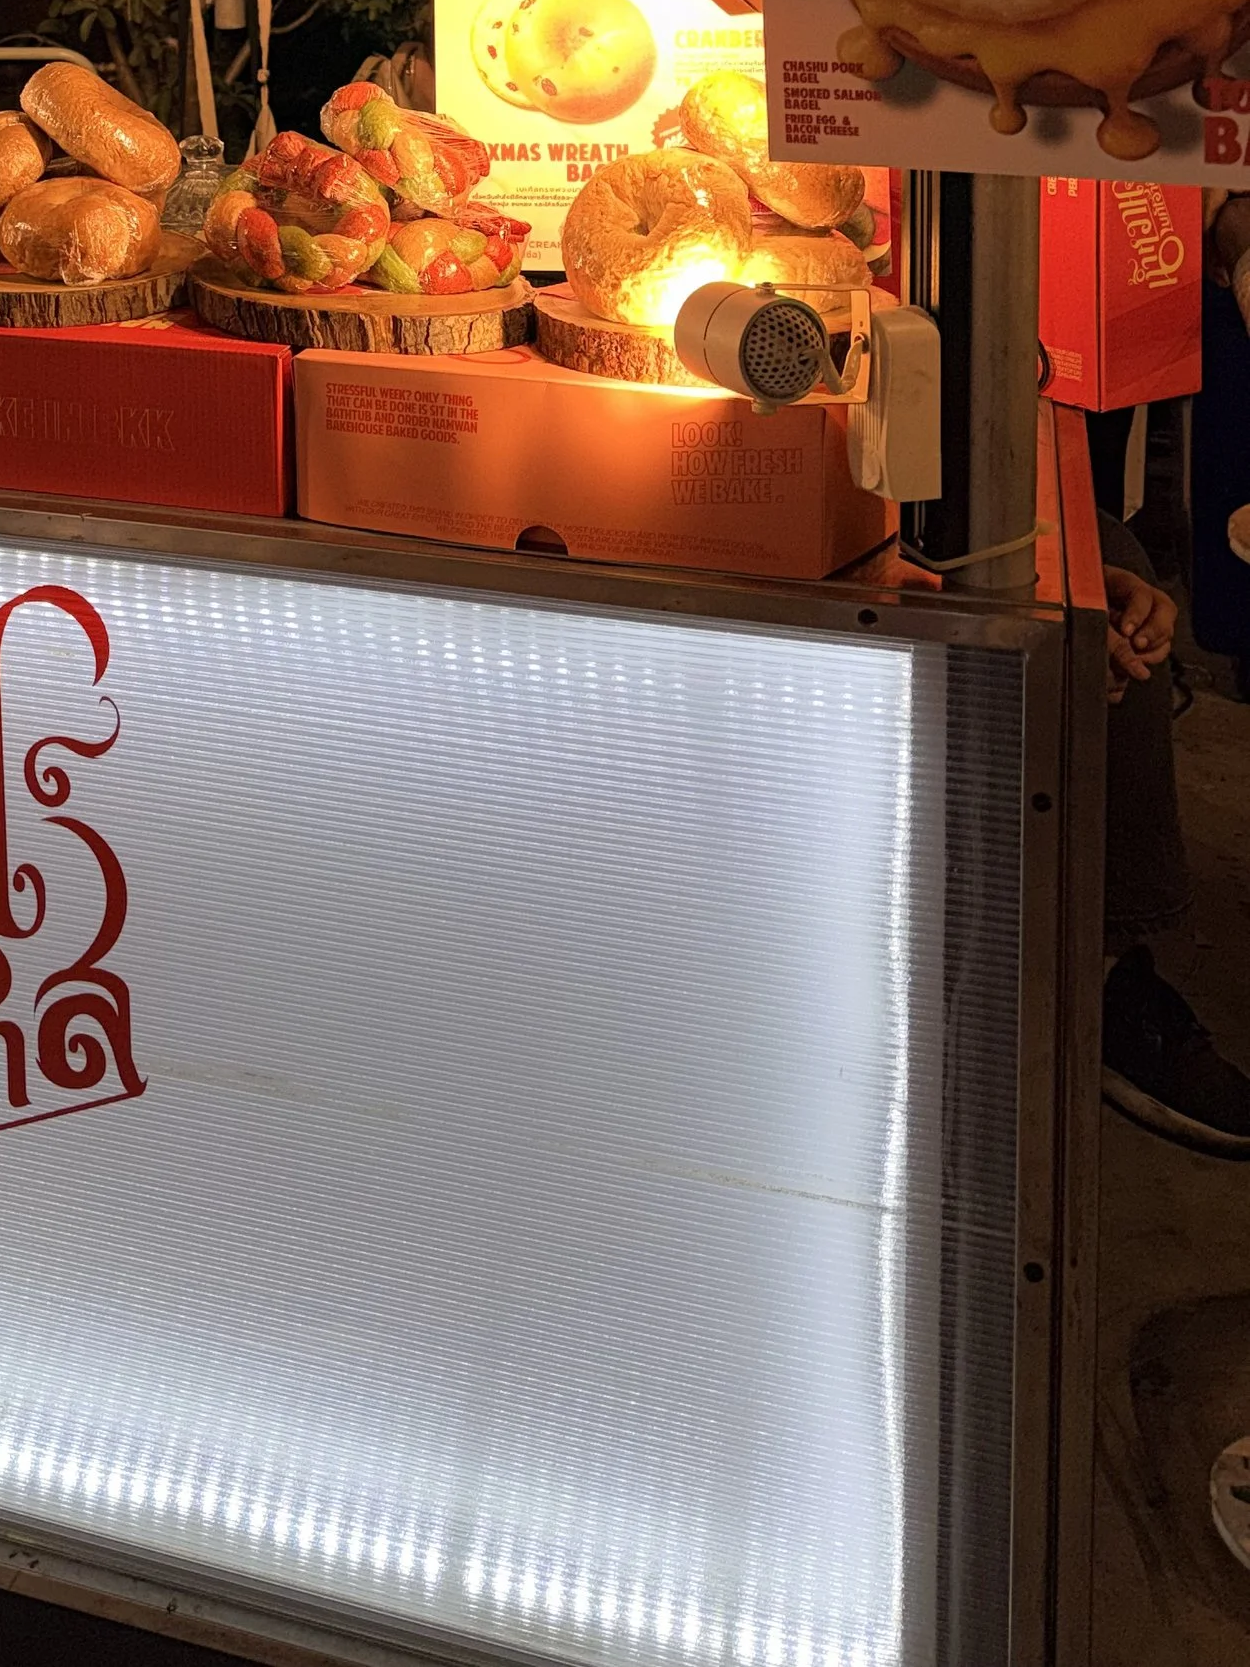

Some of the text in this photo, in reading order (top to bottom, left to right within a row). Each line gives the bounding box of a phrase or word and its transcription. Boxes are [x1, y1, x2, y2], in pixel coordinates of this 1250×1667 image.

[783, 60, 864, 74] CHASHU PORK
[783, 72, 820, 84] BAGEL
[784, 87, 882, 102] SMOKED SALMON
[784, 99, 821, 111] BAGEL
[785, 114, 850, 125] FRIED EGG &
[785, 124, 860, 136] BACON CHEESE
[786, 134, 819, 144] BAGEL
[487, 143, 629, 162] XMAS WREATH
[326, 382, 473, 407] STRESSFUL WEEK? ONLY THING
[326, 394, 479, 421] THAT CAN BE DONE IS SIT IN THE
[326, 407, 478, 434] BATHTUB AND ORDER NAMWAN
[326, 419, 461, 445] BAKEHOUSE BAKED GOODS.
[672, 421, 743, 448] LOOK!
[671, 447, 803, 477] HOW FRESH
[671, 478, 707, 505] WE
